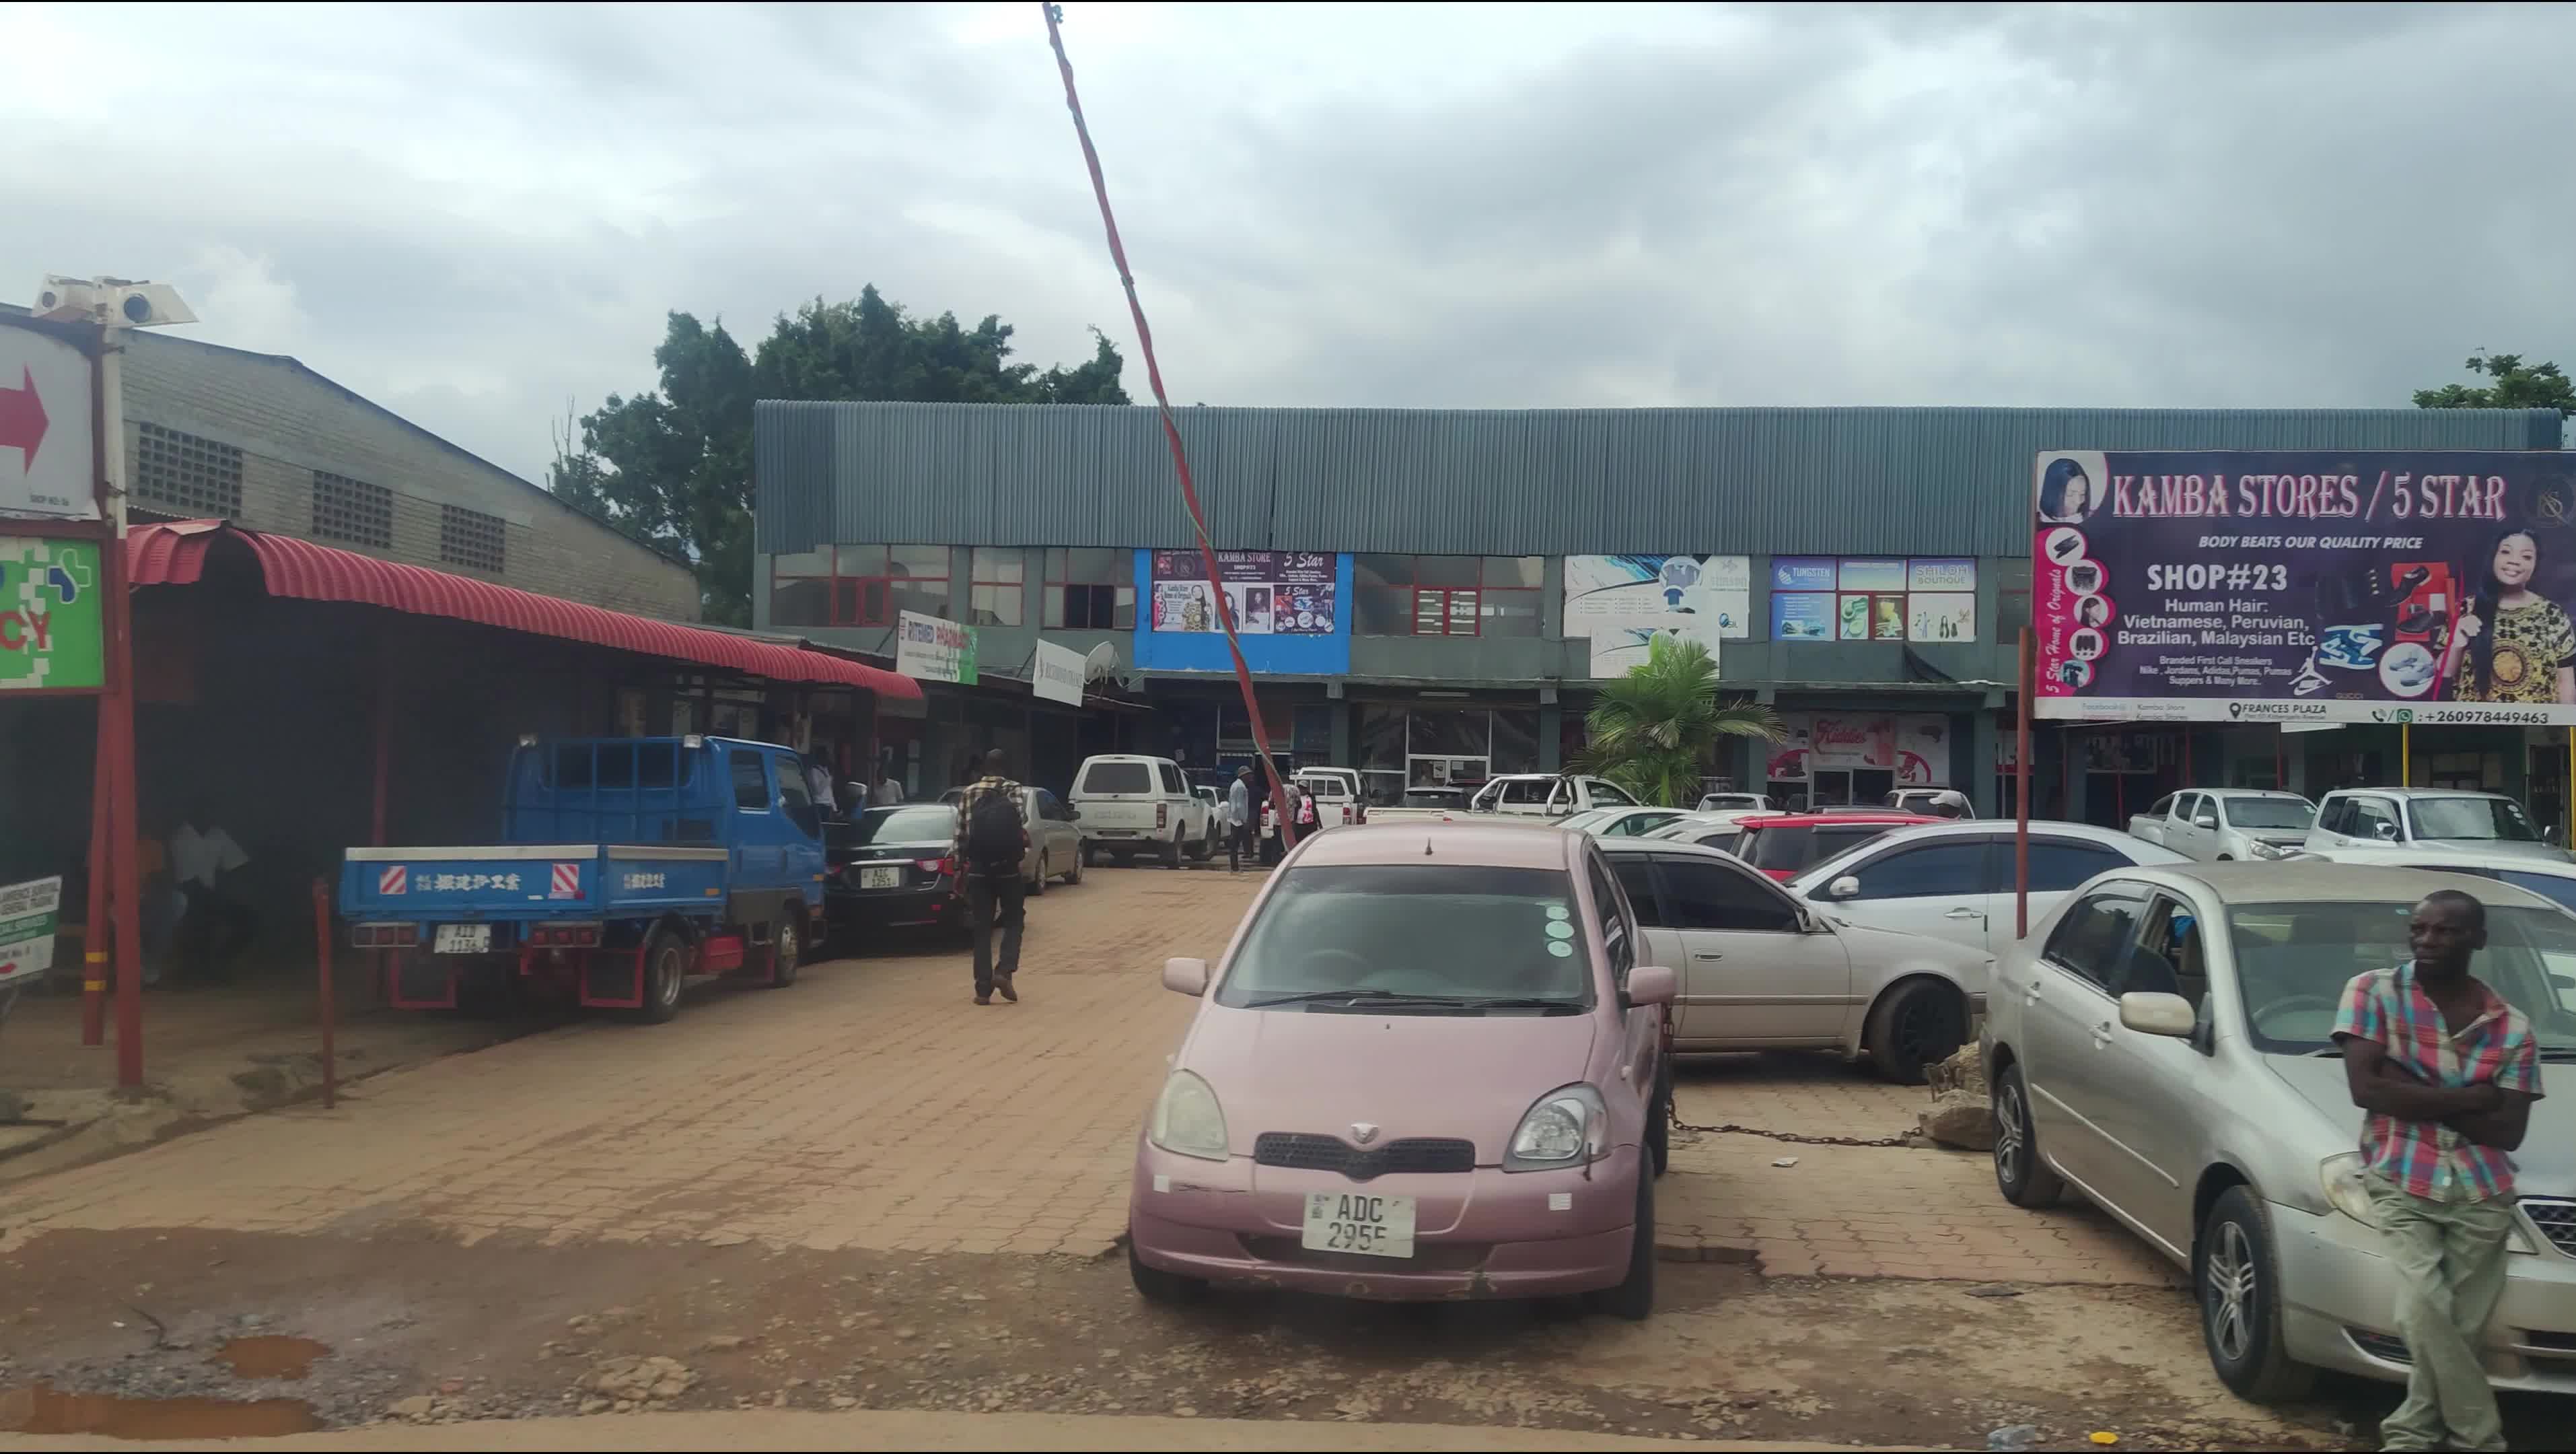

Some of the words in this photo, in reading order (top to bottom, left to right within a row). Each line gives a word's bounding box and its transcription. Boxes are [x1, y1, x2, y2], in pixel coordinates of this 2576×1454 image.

[2112, 474, 2231, 518] KAMBA
[2237, 474, 2359, 520] STORES
[2364, 470, 2387, 523] /
[2392, 471, 2412, 519] 5
[2419, 475, 2507, 522] STAR
[2198, 536, 2240, 548] BODY
[2240, 536, 2281, 548] BEATS
[2285, 536, 2316, 549] OUR
[2319, 536, 2382, 550] QUALITY
[2382, 537, 2423, 549] PRICE
[1218, 552, 1245, 563] KAMBA
[1247, 552, 1271, 563] STORE
[1283, 551, 1293, 567] 5
[1296, 552, 1324, 568] Star
[1793, 567, 1830, 577] TUNGSTEN
[1916, 565, 1969, 576] SHILOH
[2147, 563, 2288, 591] SHOP#23
[1917, 576, 1966, 584] BOUTIQUE
[1284, 586, 1291, 596] 5
[1292, 586, 1309, 596] Star
[2165, 598, 2225, 613] Human
[2229, 598, 2269, 613] Hair:
[2046, 613, 2066, 625] of
[2123, 615, 2227, 631] Vietnamese,
[2231, 615, 2310, 631] Peruvian,
[2045, 626, 2062, 656] Home
[2117, 630, 2197, 647] Brazilian,
[2201, 630, 2283, 649] Malaysian
[2287, 631, 2316, 646] Etc
[2159, 656, 2196, 664] Branded
[2234, 657, 2273, 665] Sneakers
[2046, 658, 2063, 683] Star
[2169, 675, 2204, 686] Suppers
[2213, 676, 2235, 687] Many
[2045, 684, 2060, 693] 5
[2242, 703, 2289, 714] FRANCES
[2293, 705, 2327, 714] PLAZA
[1336, 1193, 1384, 1222] ADC
